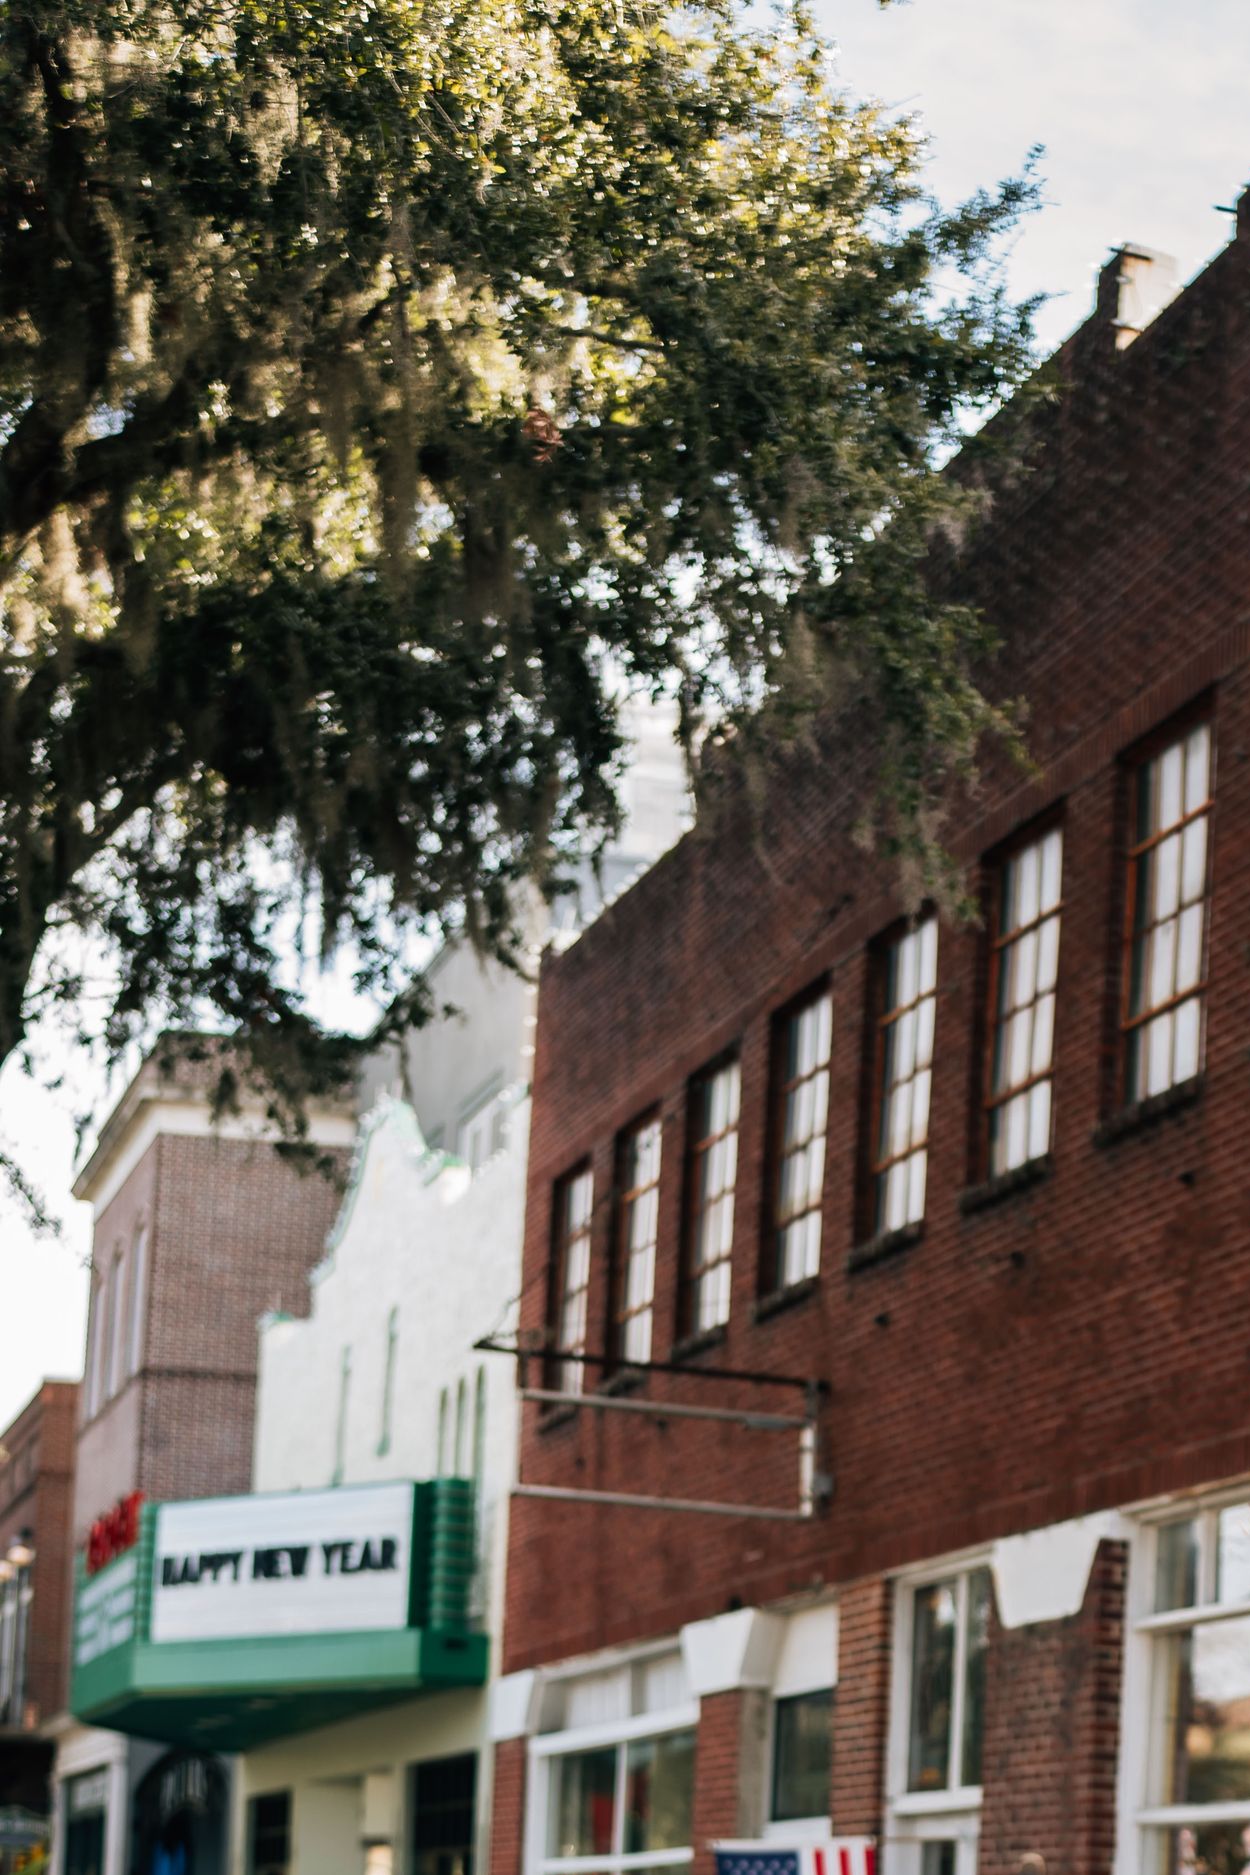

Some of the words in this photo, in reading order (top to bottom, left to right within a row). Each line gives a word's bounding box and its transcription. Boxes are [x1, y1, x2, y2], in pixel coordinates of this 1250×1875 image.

[162, 1551, 243, 1586] HAPPY
[253, 1546, 311, 1579] NEW
[321, 1538, 397, 1574] YEAR
